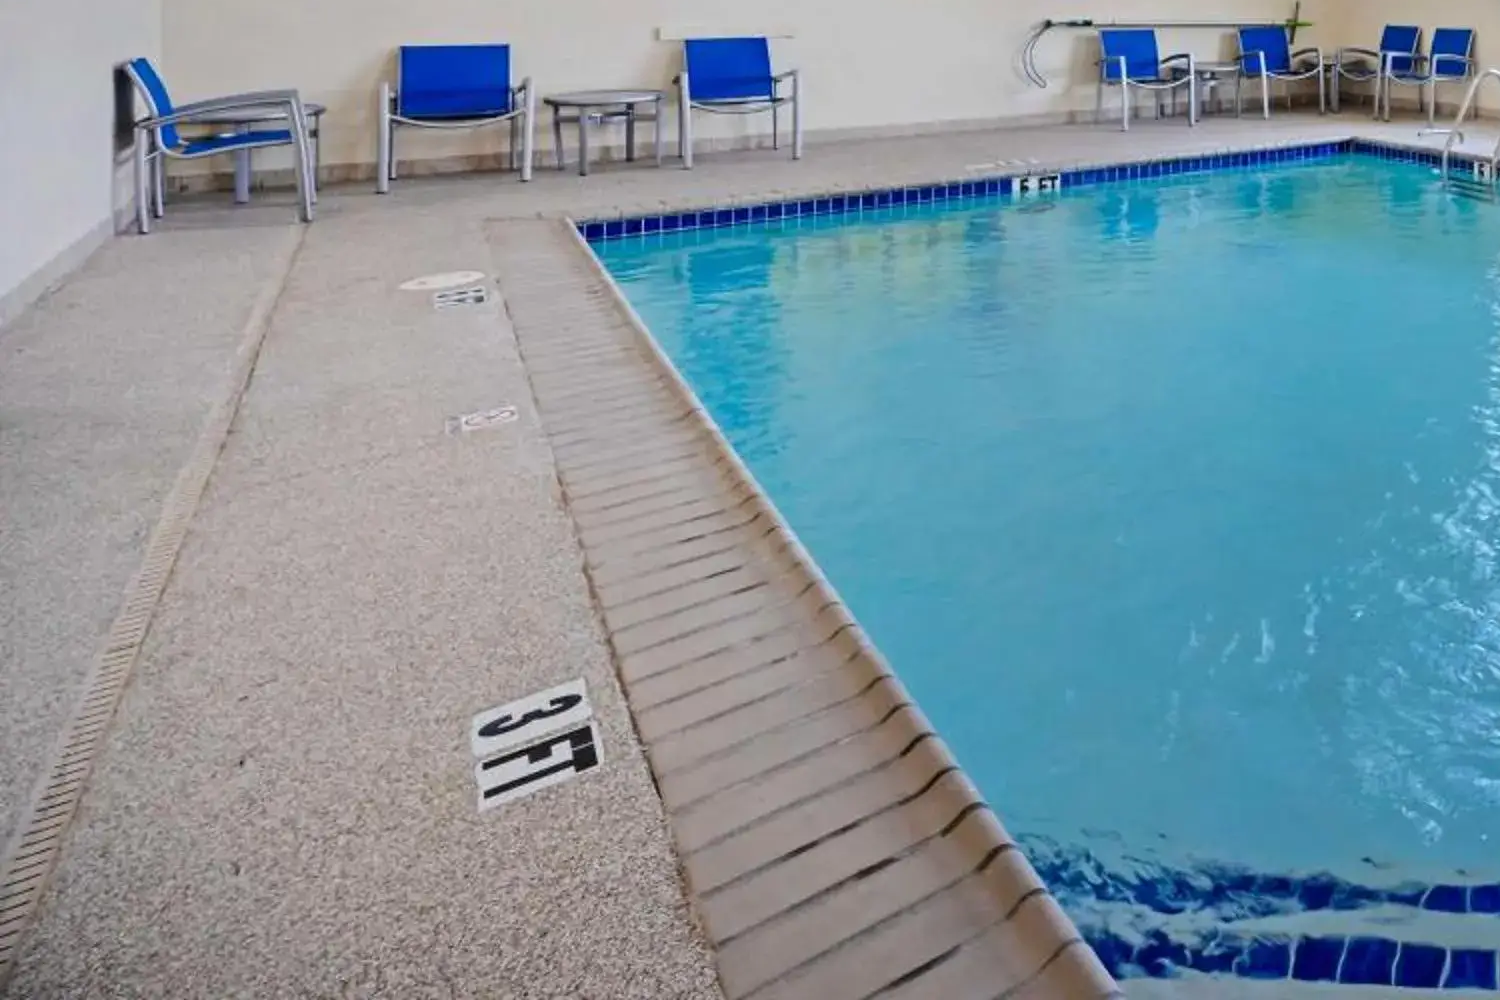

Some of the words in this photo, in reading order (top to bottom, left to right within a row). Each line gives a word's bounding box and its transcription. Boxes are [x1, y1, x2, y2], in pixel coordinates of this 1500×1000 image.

[1039, 175, 1058, 191] FT
[478, 693, 582, 737] 3
[481, 725, 599, 799] FT
